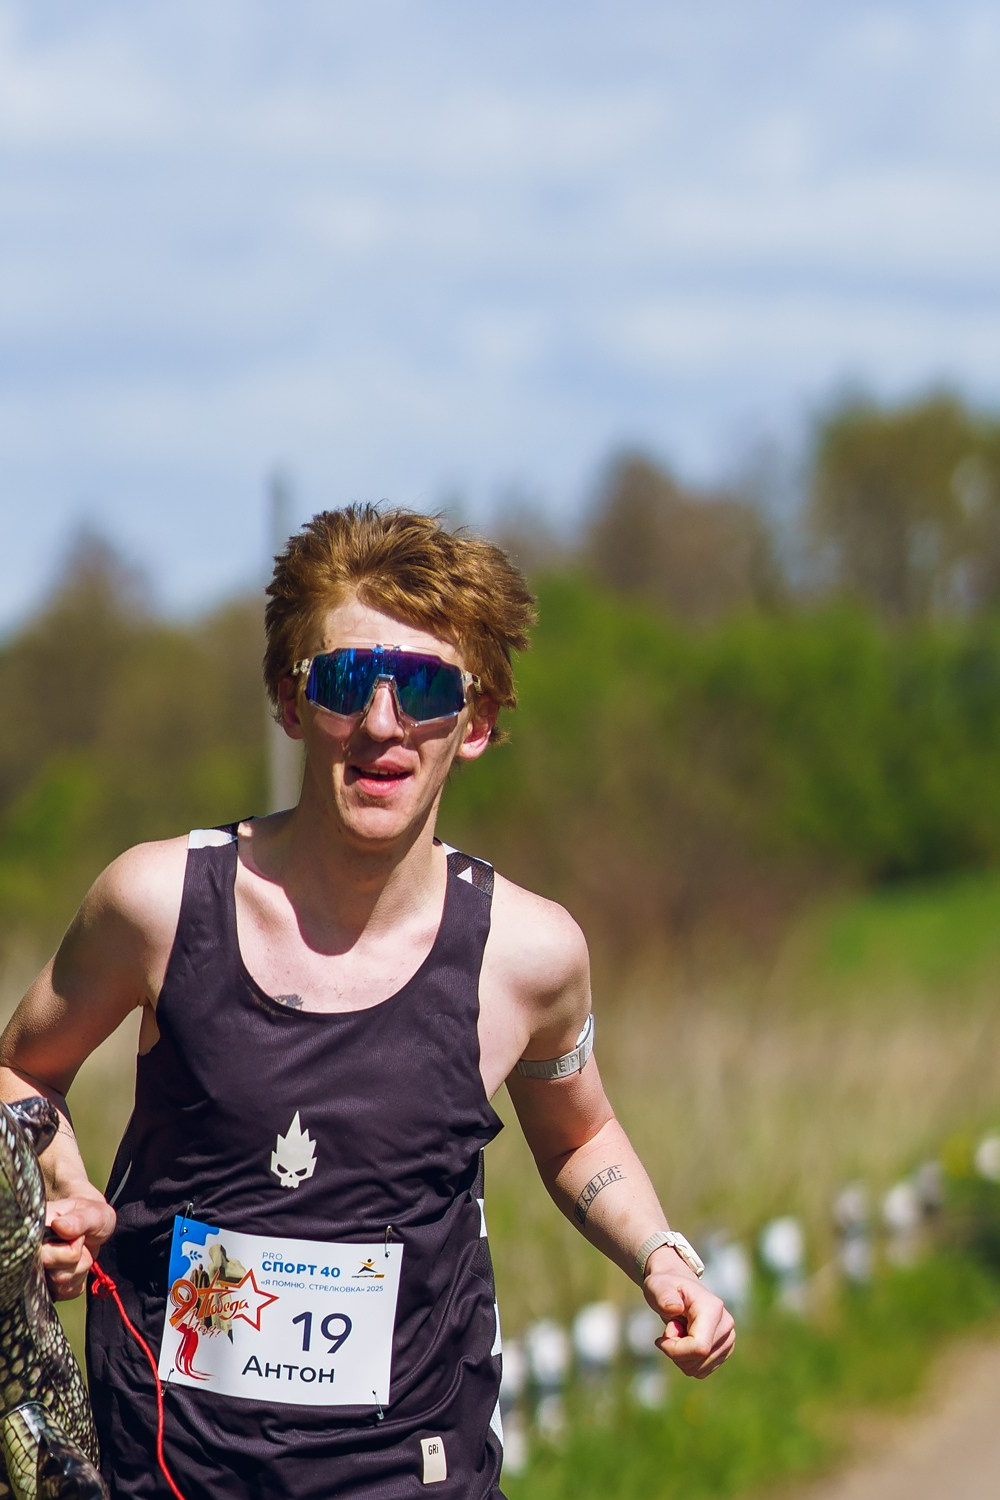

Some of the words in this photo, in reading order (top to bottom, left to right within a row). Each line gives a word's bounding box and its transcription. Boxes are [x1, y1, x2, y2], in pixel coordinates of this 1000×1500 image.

[262, 1251, 283, 1261] PRO
[262, 1260, 318, 1276] СПОРТ
[320, 1266, 341, 1278] 40
[366, 1285, 384, 1293] 2025
[292, 1311, 353, 1354] 19
